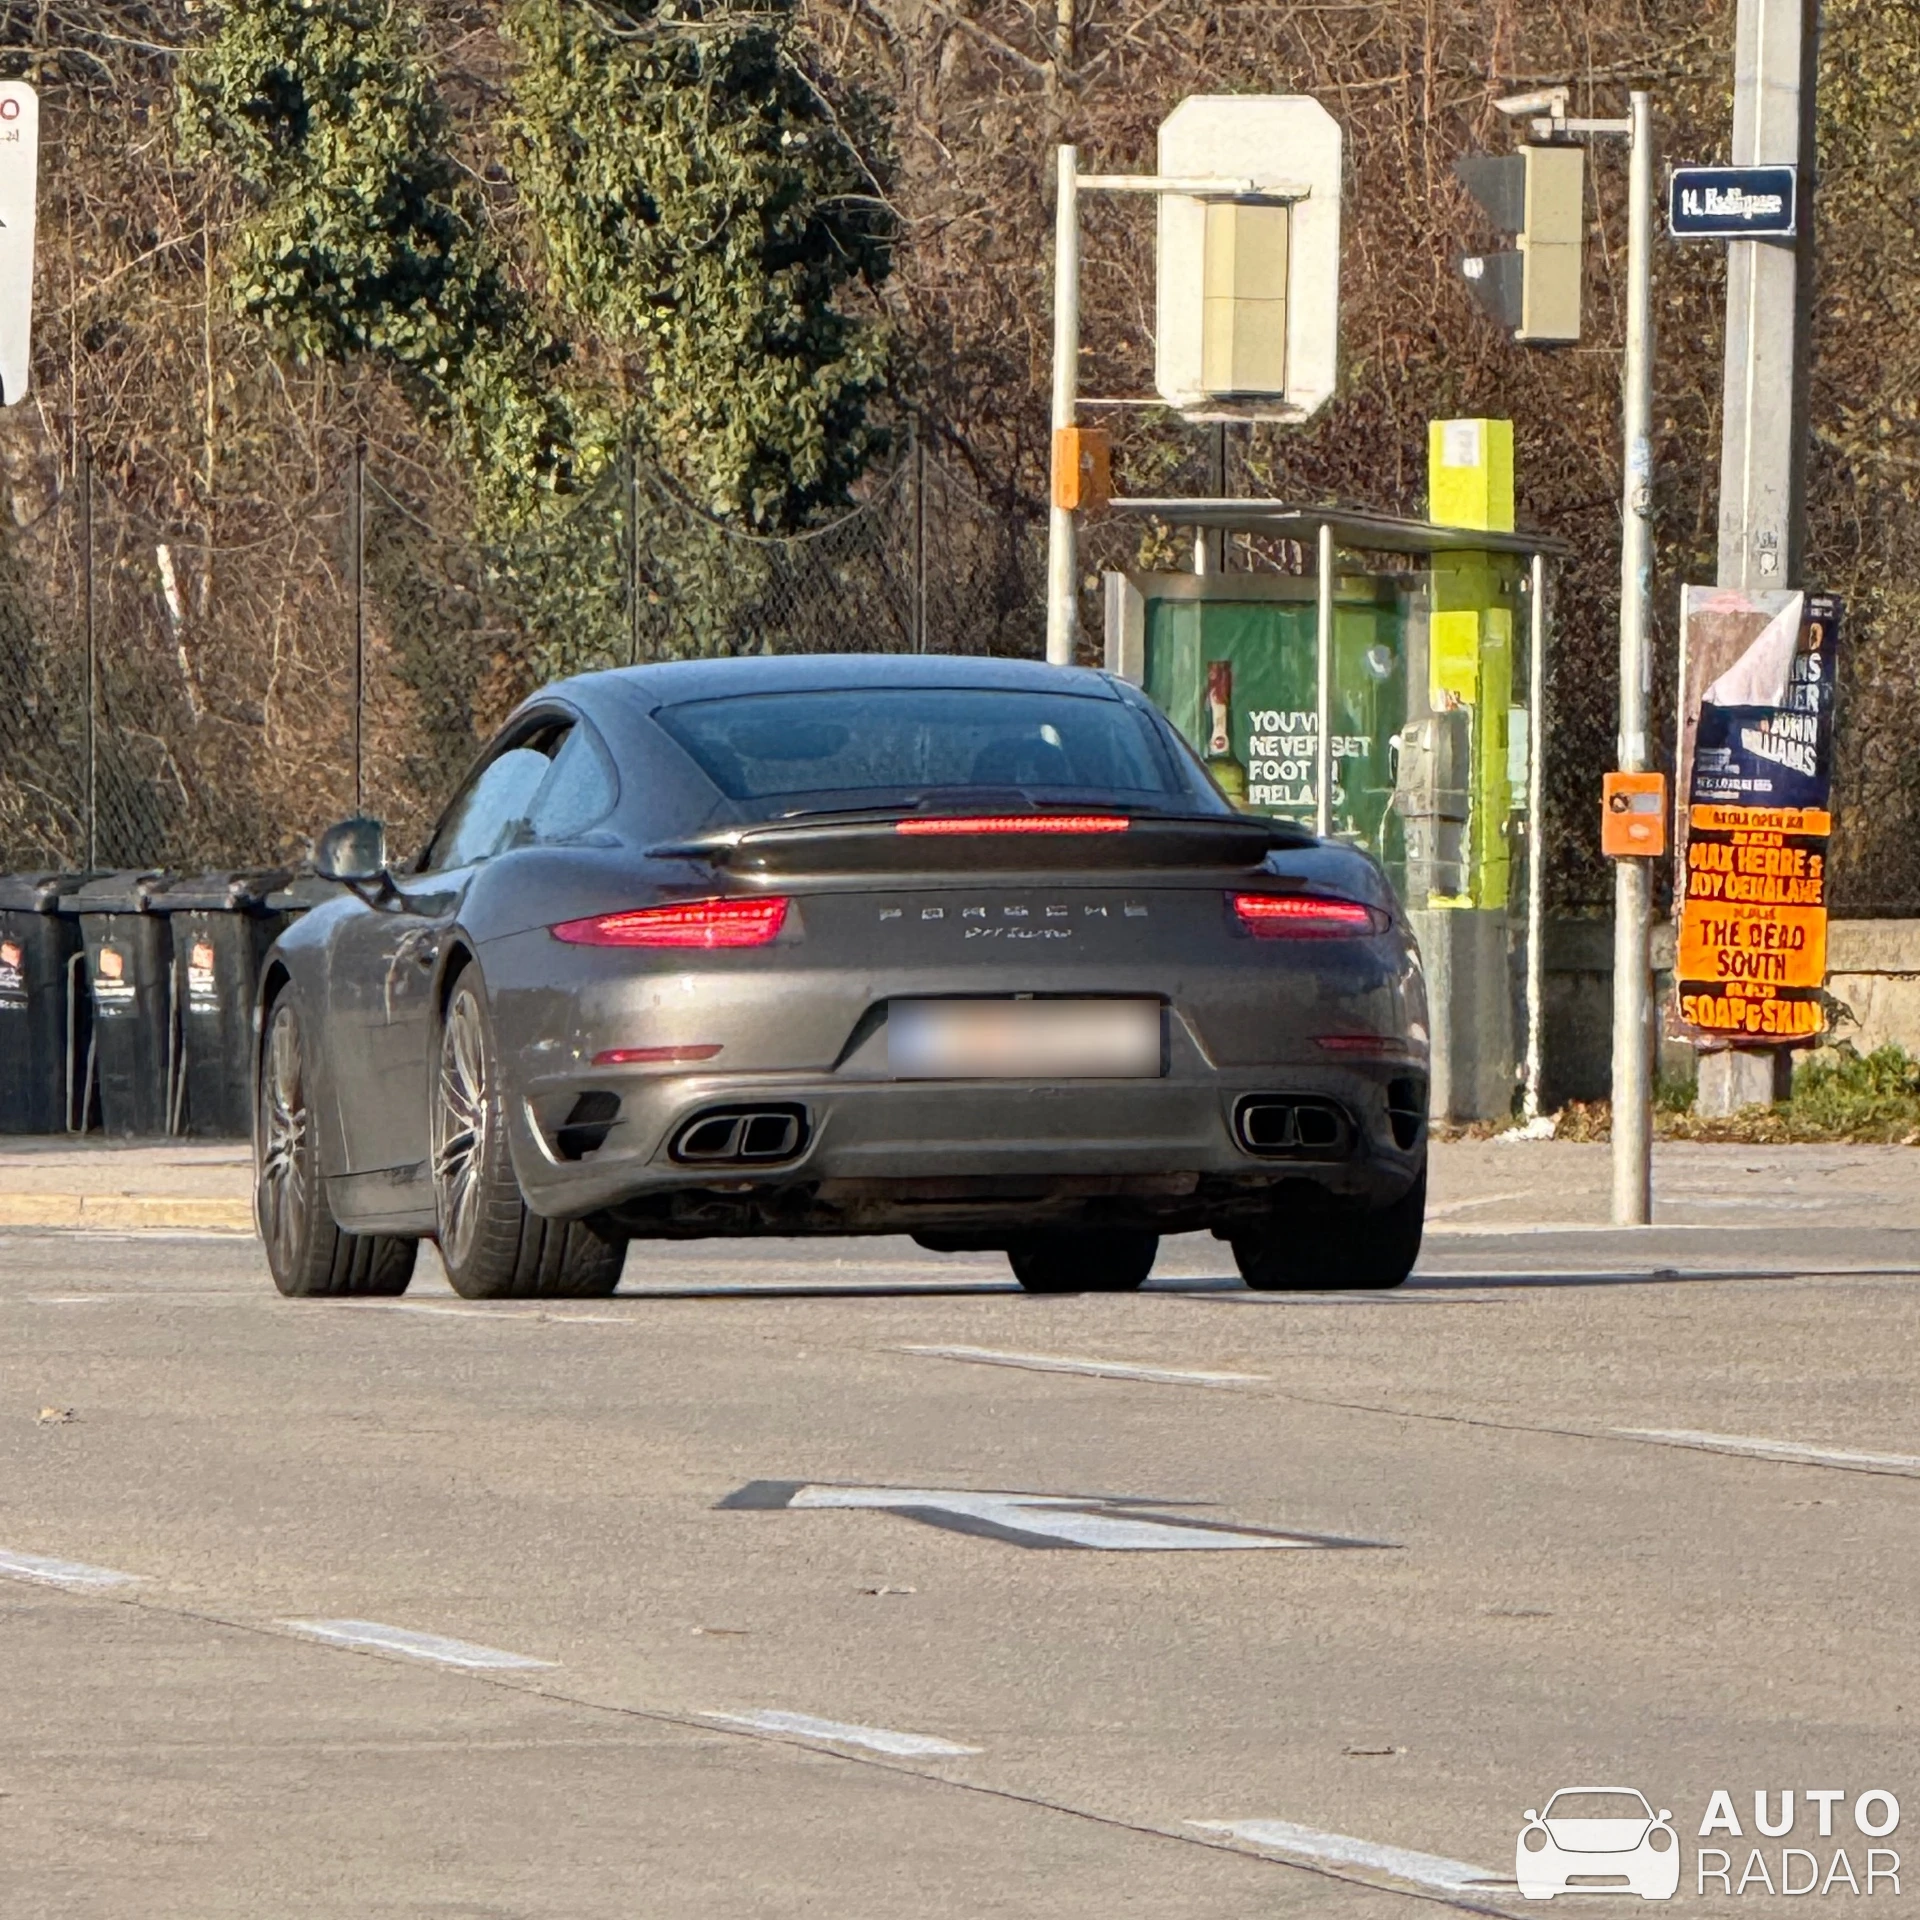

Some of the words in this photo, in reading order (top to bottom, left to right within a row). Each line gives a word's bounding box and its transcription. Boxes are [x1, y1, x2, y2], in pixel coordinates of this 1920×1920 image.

[1249, 711, 1318, 732] YOU'V
[1331, 736, 1371, 757] SET
[1249, 760, 1311, 780] FOOT
[1249, 784, 1345, 806] IRELAD
[1701, 920, 1740, 946] THE
[1750, 924, 1805, 950] DEAD
[1717, 950, 1786, 980] SOUTH
